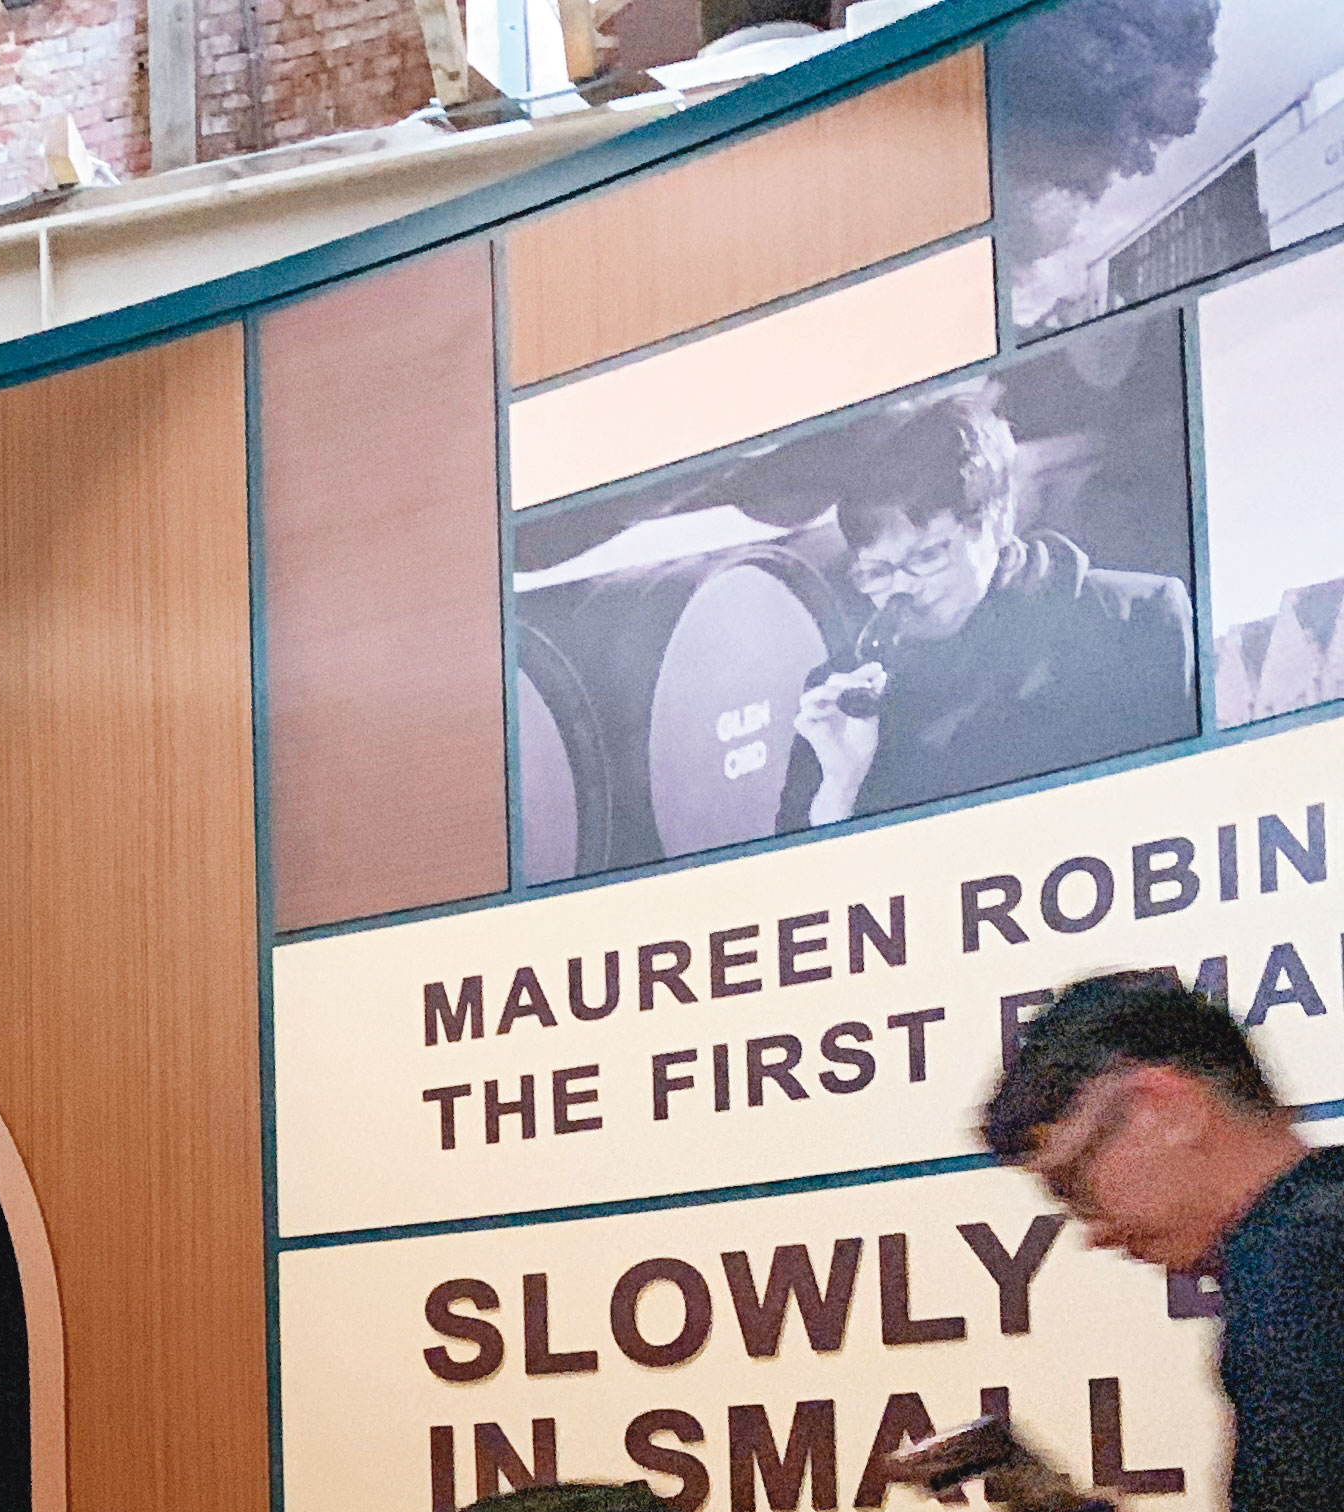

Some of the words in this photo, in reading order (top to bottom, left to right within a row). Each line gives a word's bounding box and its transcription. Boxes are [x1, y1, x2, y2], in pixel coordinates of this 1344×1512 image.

[422, 894, 909, 1048] MAUREEN
[959, 804, 1328, 955] ROBIN
[422, 1062, 603, 1151] THE
[651, 1006, 946, 1122] FIRST
[421, 1214, 1066, 1383] SLOWLY
